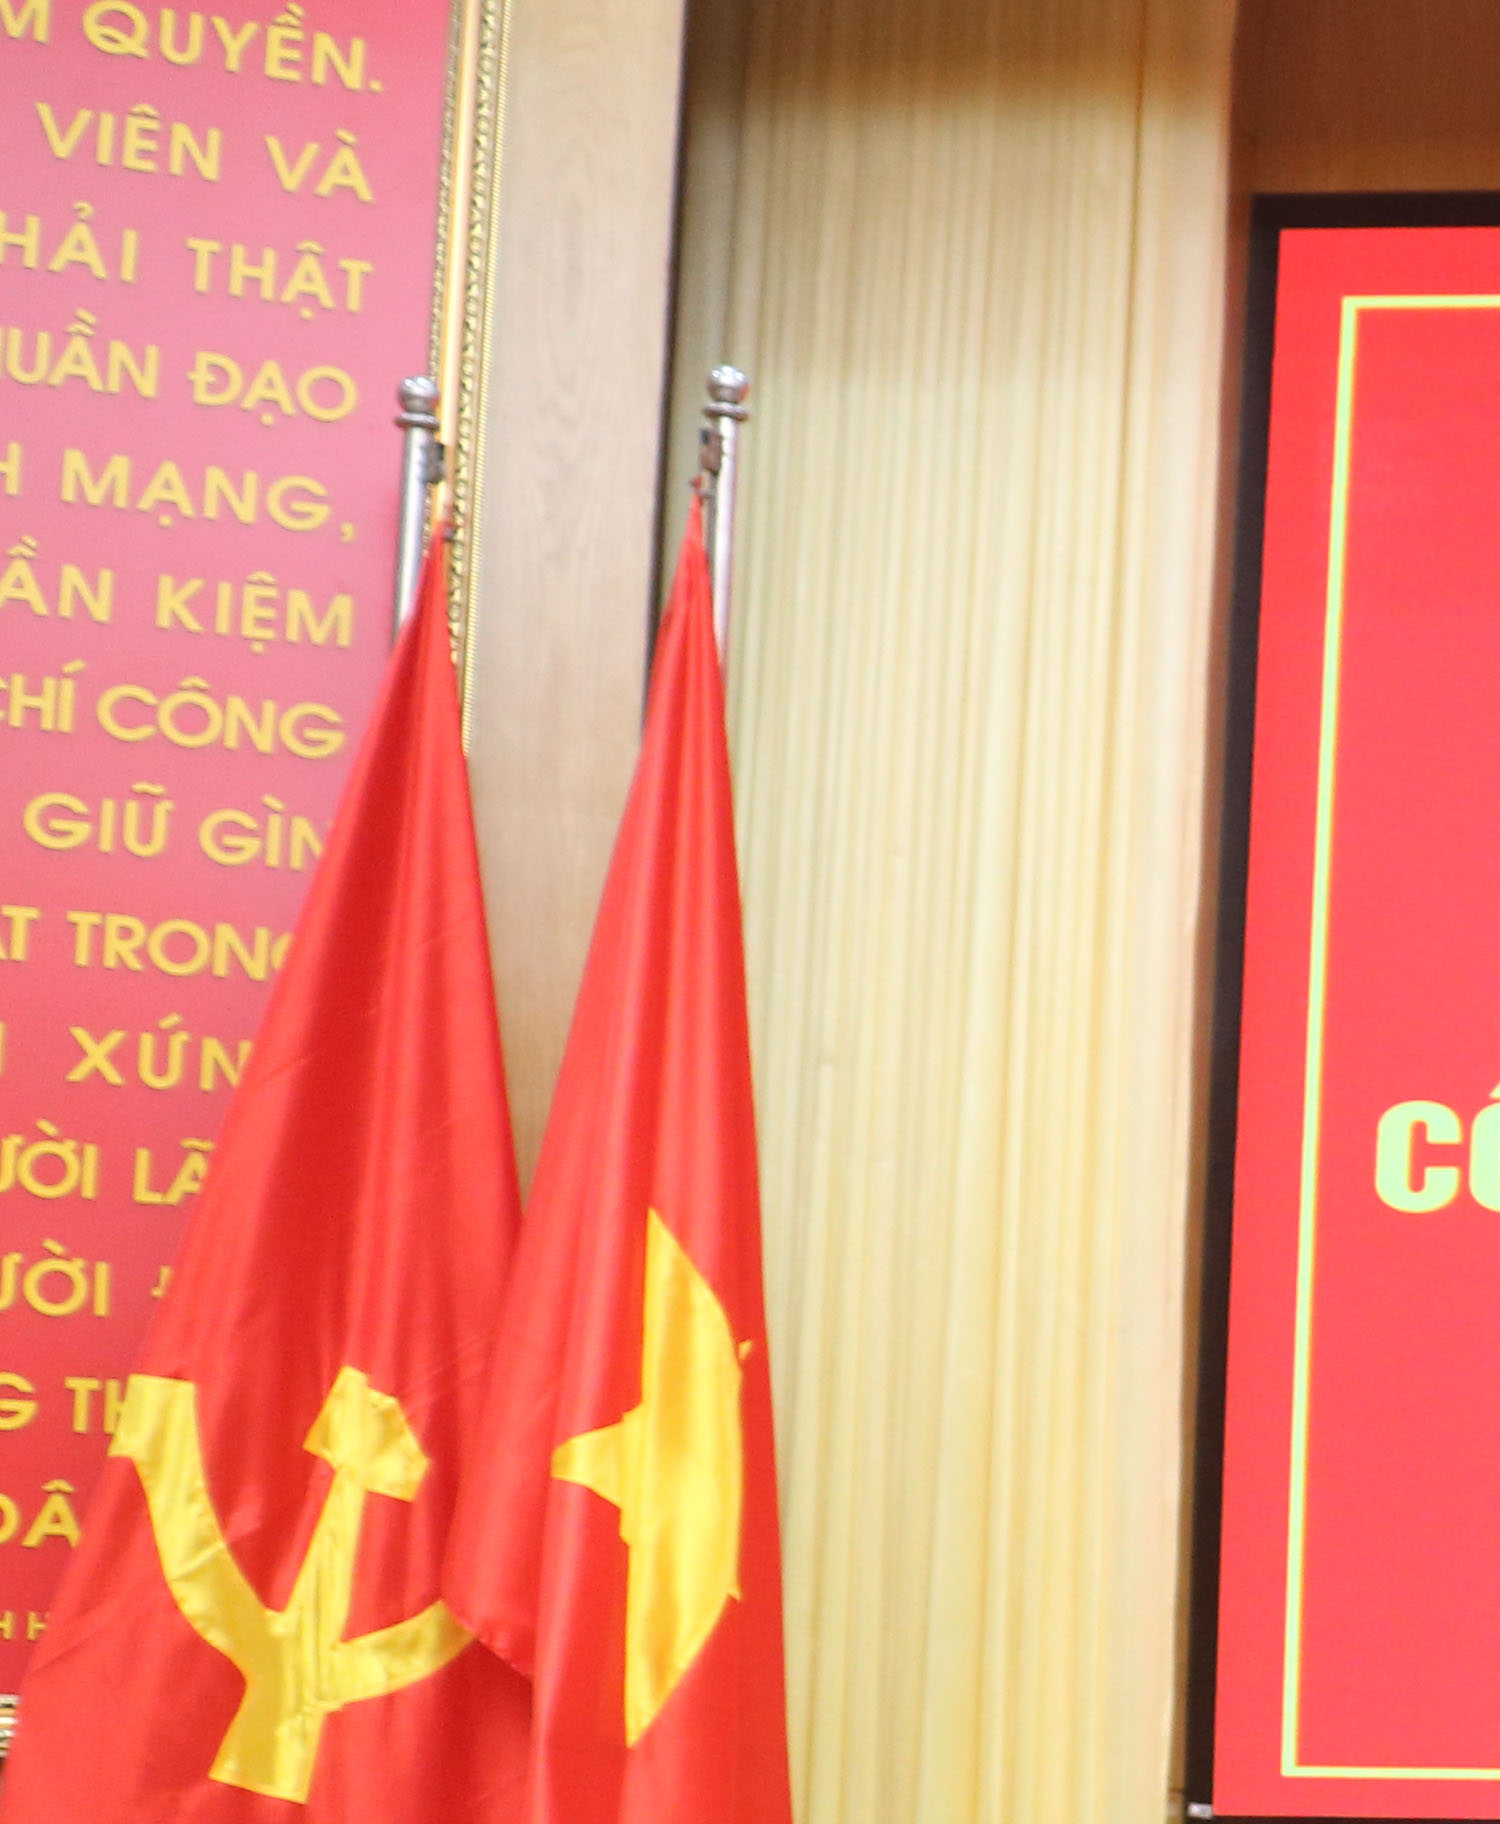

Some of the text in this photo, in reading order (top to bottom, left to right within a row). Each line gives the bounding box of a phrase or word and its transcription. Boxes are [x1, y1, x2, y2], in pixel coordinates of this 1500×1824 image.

[81, 0, 385, 92] QUYỀN.
[35, 102, 374, 205] VIÊN VÀ
[186, 237, 375, 321] THẬT
[0, 306, 359, 426] UẦN ĐẠO
[61, 447, 357, 543] MẠNG,
[155, 570, 356, 654] KIỆM
[0, 658, 348, 761] HÍ CÔNG
[22, 780, 175, 859] GIỮ
[0, 903, 44, 963] T
